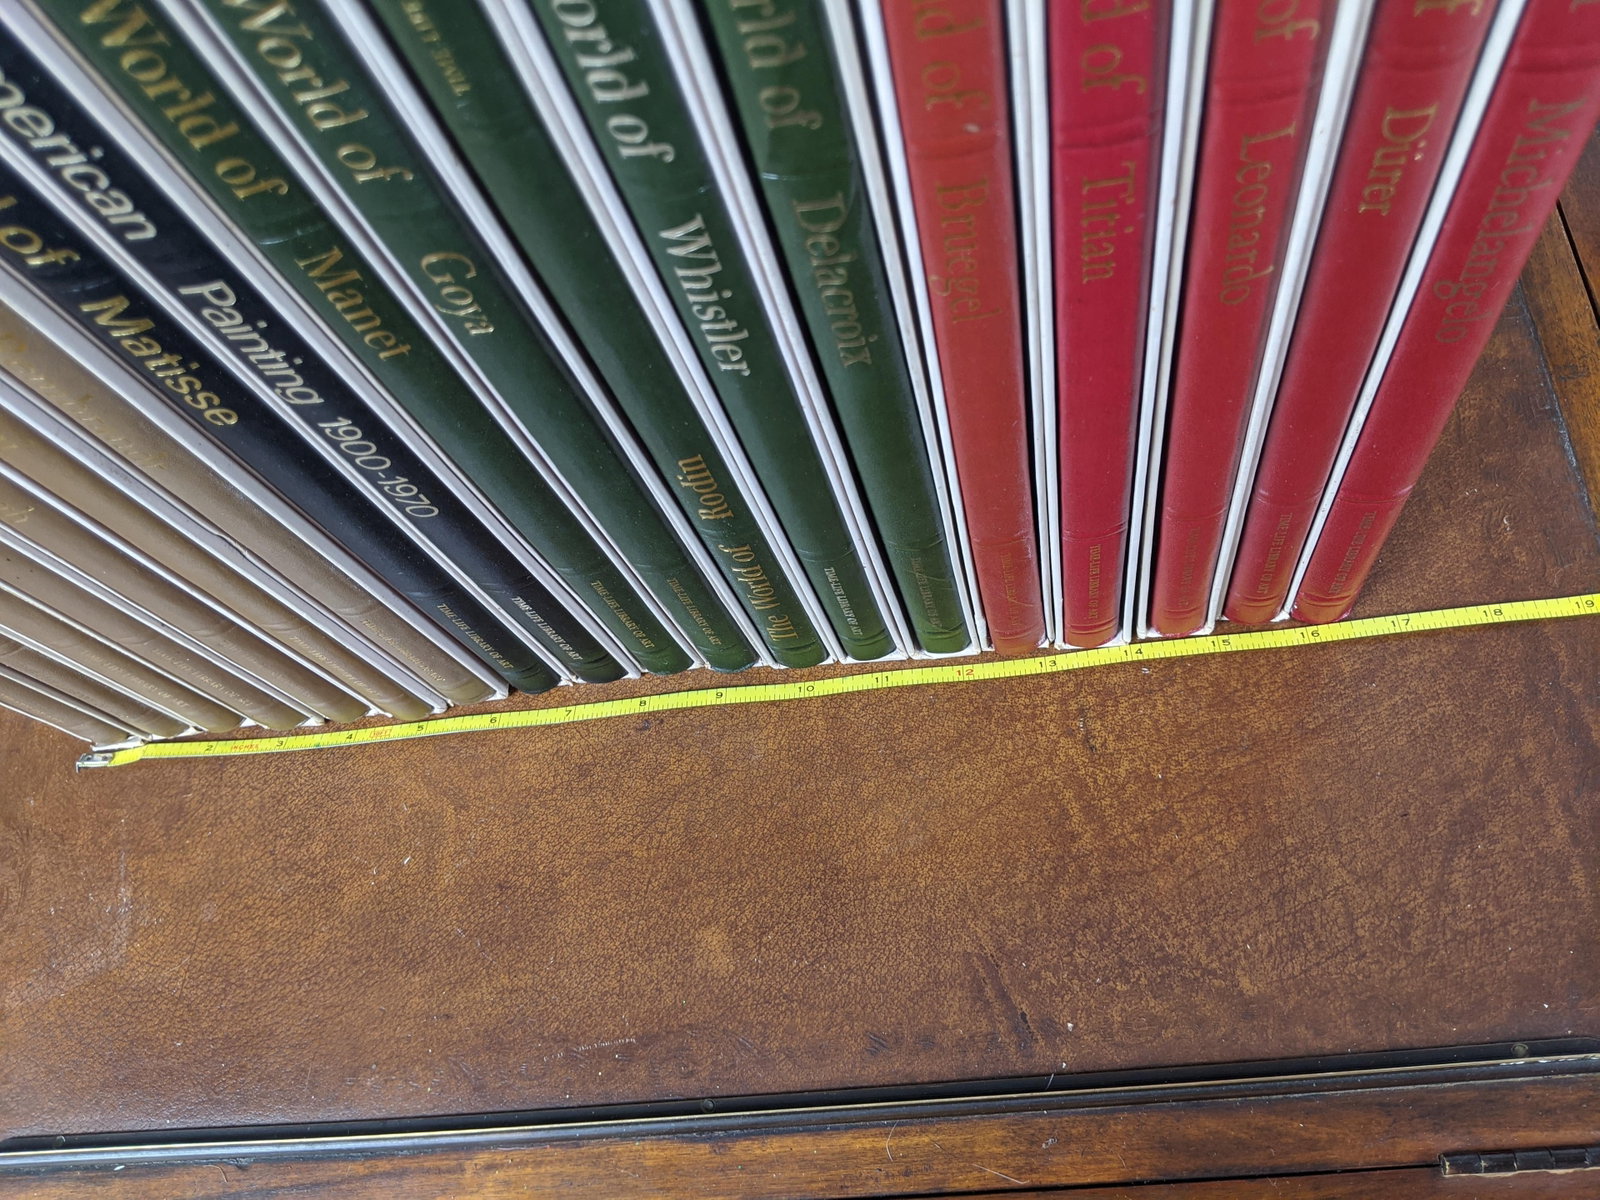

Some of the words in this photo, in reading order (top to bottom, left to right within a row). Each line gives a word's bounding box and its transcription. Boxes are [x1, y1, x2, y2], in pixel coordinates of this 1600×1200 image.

[920, 60, 991, 111] of
[1081, 44, 1147, 95] of
[1358, 104, 1438, 217] Dürer
[81, 0, 239, 151] World
[215, 157, 289, 200] of
[295, 246, 412, 361] Manet
[553, 0, 650, 104] orld
[608, 113, 675, 164] of
[659, 214, 751, 377] Whistler
[759, 85, 823, 130] of
[793, 191, 873, 369] Delacroix
[1081, 161, 1136, 284] Titian
[1219, 121, 1297, 307] Leonardo
[1434, 97, 1587, 344] Michelangelo
[337, 143, 413, 184] of
[421, 252, 495, 337] Goya
[930, 178, 1002, 324] Bruegel
[0, 225, 81, 267] of
[80, 296, 239, 427] Matisse
[178, 280, 324, 407] Painting
[316, 416, 440, 519] 1900-1970
[676, 454, 734, 521] Rodin
[718, 544, 755, 563] of
[731, 563, 781, 611] World
[1575, 599, 1595, 609] 19
[767, 614, 799, 642] The
[1391, 618, 1410, 628] 17
[1483, 608, 1503, 618] 18
[1124, 647, 1143, 657] 14
[1211, 639, 1231, 648] 15
[1300, 630, 1320, 639] 16
[498, 660, 514, 669] ART
[875, 675, 889, 684] 11
[957, 668, 974, 677] 12
[1039, 660, 1057, 668] 13
[798, 685, 815, 693] 10
[565, 709, 572, 717] 7
[346, 733, 353, 741] 4
